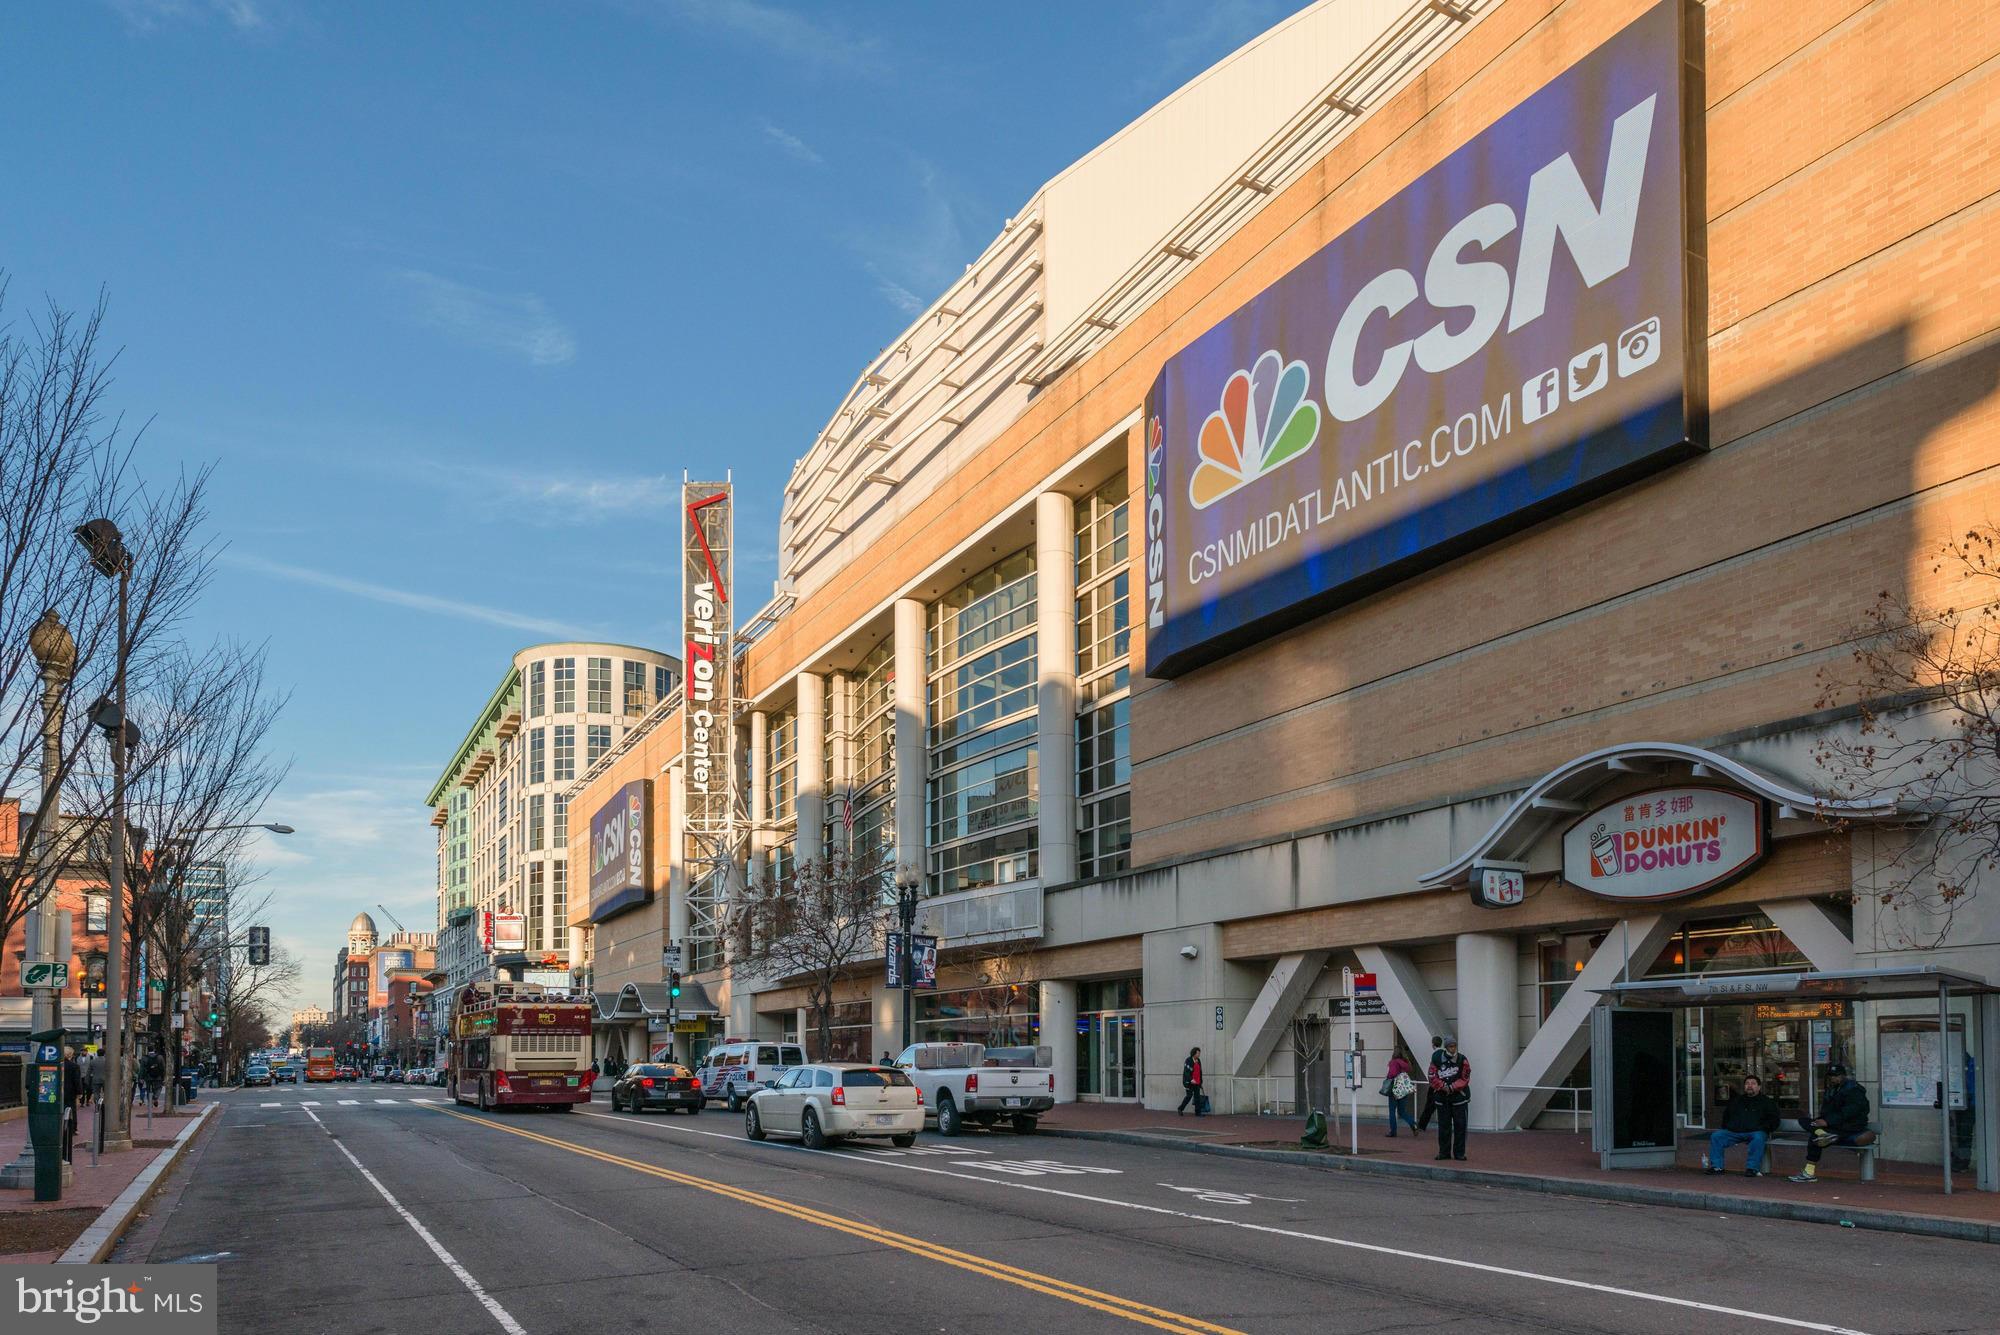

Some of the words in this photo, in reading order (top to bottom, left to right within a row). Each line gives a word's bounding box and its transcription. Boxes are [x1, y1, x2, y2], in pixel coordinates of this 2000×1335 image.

[1324, 92, 1658, 422] CSN
[1188, 394, 1512, 586] CSNMIDATLANTIC.COM
[1148, 493, 1164, 630] CSN
[687, 581, 721, 702] verizon
[693, 709, 714, 795] Center
[1623, 795, 1694, 822] 當肯多娜
[603, 808, 626, 866] CSN
[1624, 816, 1727, 851] DUNKIN'
[1624, 840, 1722, 873] DONUTS
[629, 828, 642, 886] CSN
[484, 911, 493, 954] REGAL
[56, 964, 65, 974] 2
[888, 935, 900, 985] wizards
[1755, 983, 1769, 992] NW
[44, 1046, 57, 1061] P
[947, 1160, 1125, 1176] BUS
